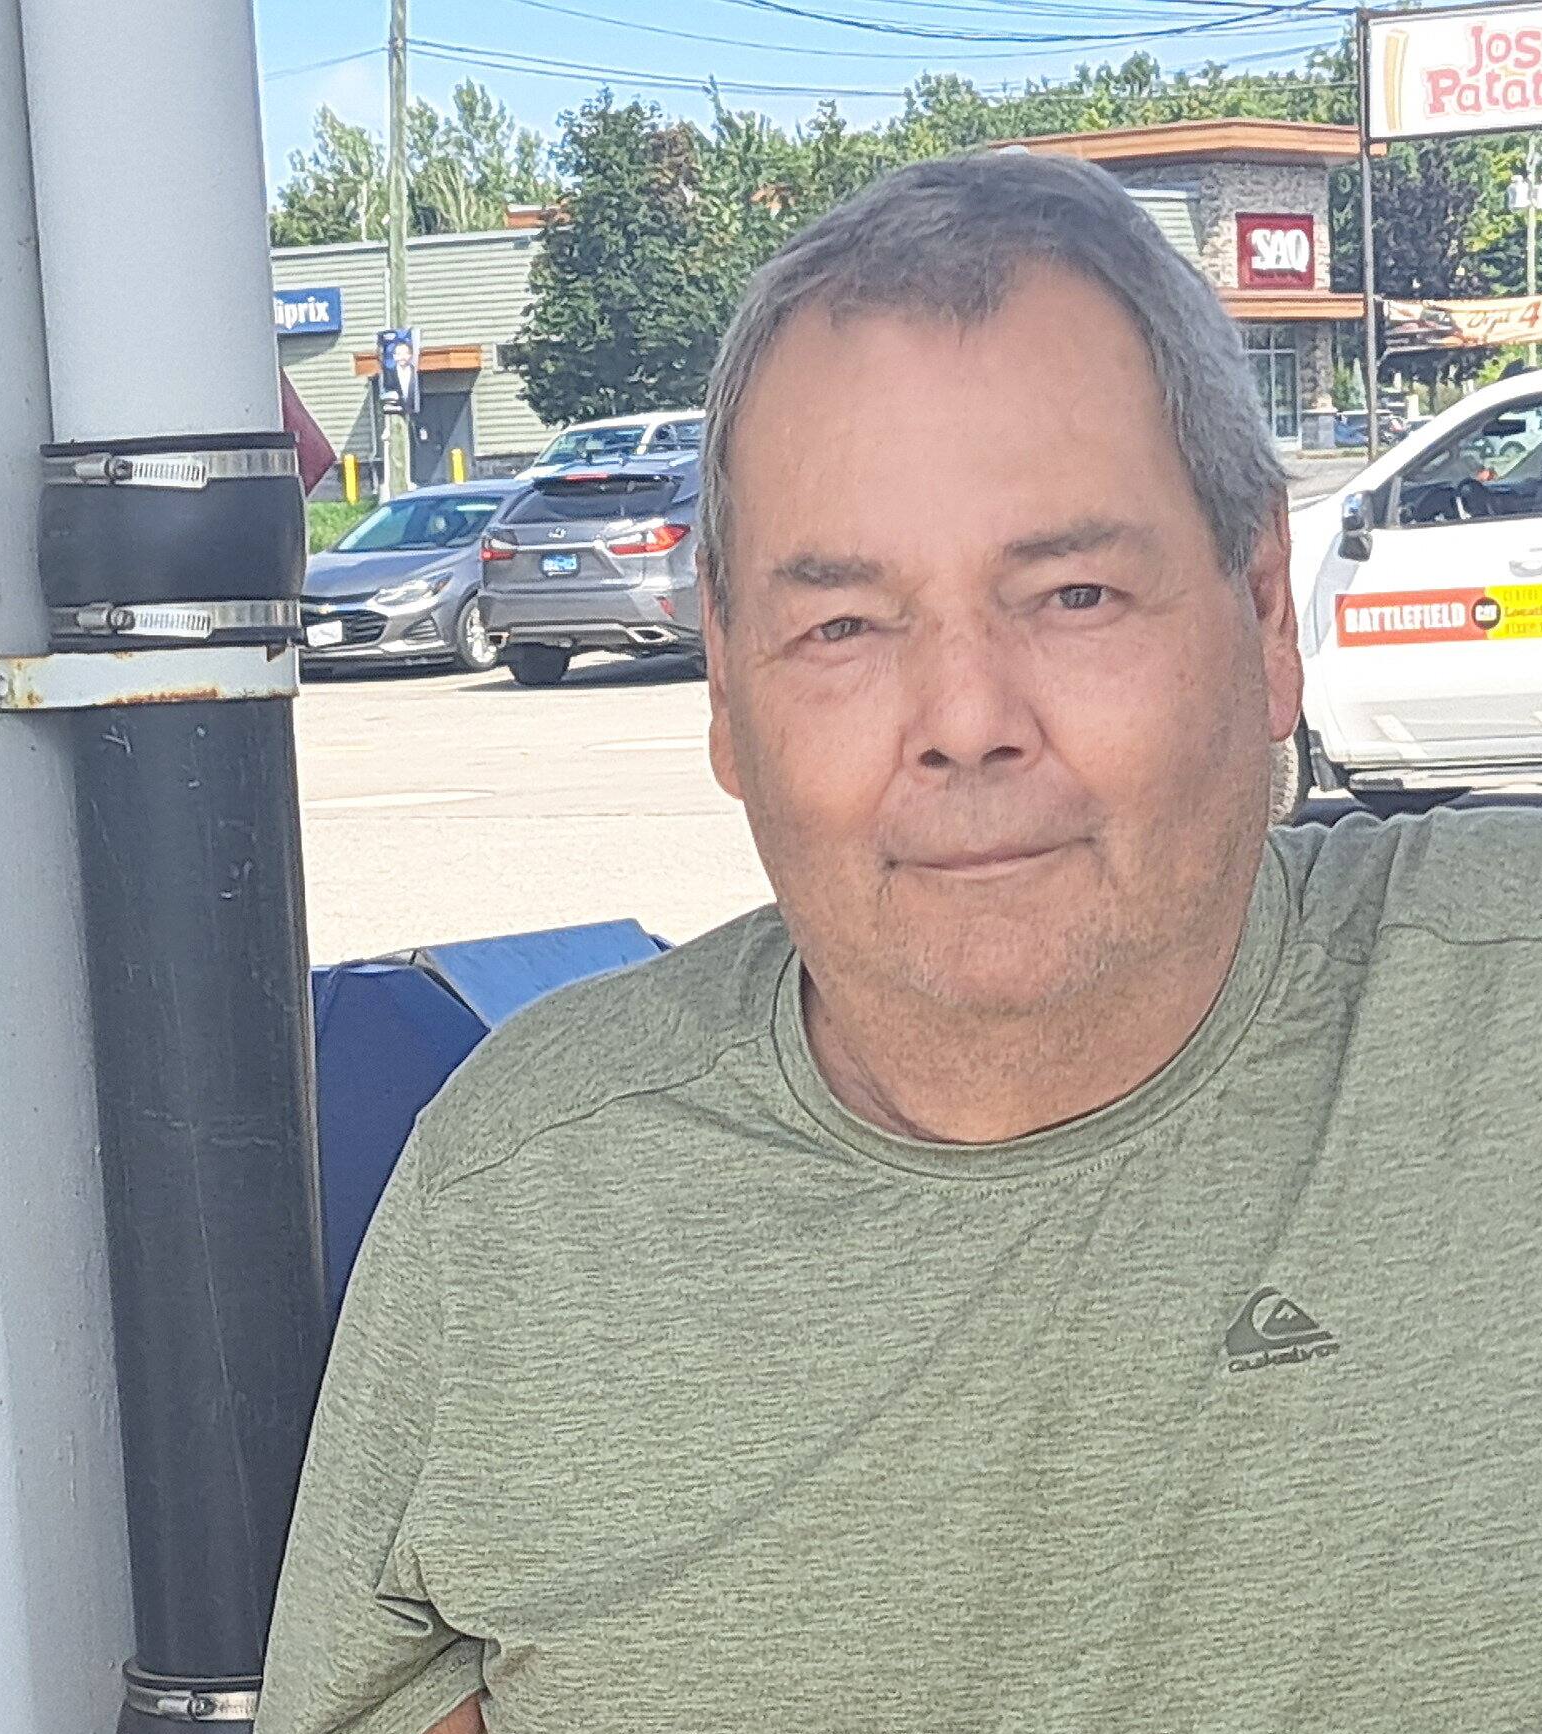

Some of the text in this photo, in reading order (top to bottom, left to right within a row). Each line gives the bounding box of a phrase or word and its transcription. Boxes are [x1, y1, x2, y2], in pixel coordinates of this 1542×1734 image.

[1466, 25, 1542, 77] Jos
[1251, 229, 1310, 272] SAQ
[1344, 601, 1466, 633] BATTLEFIELD
